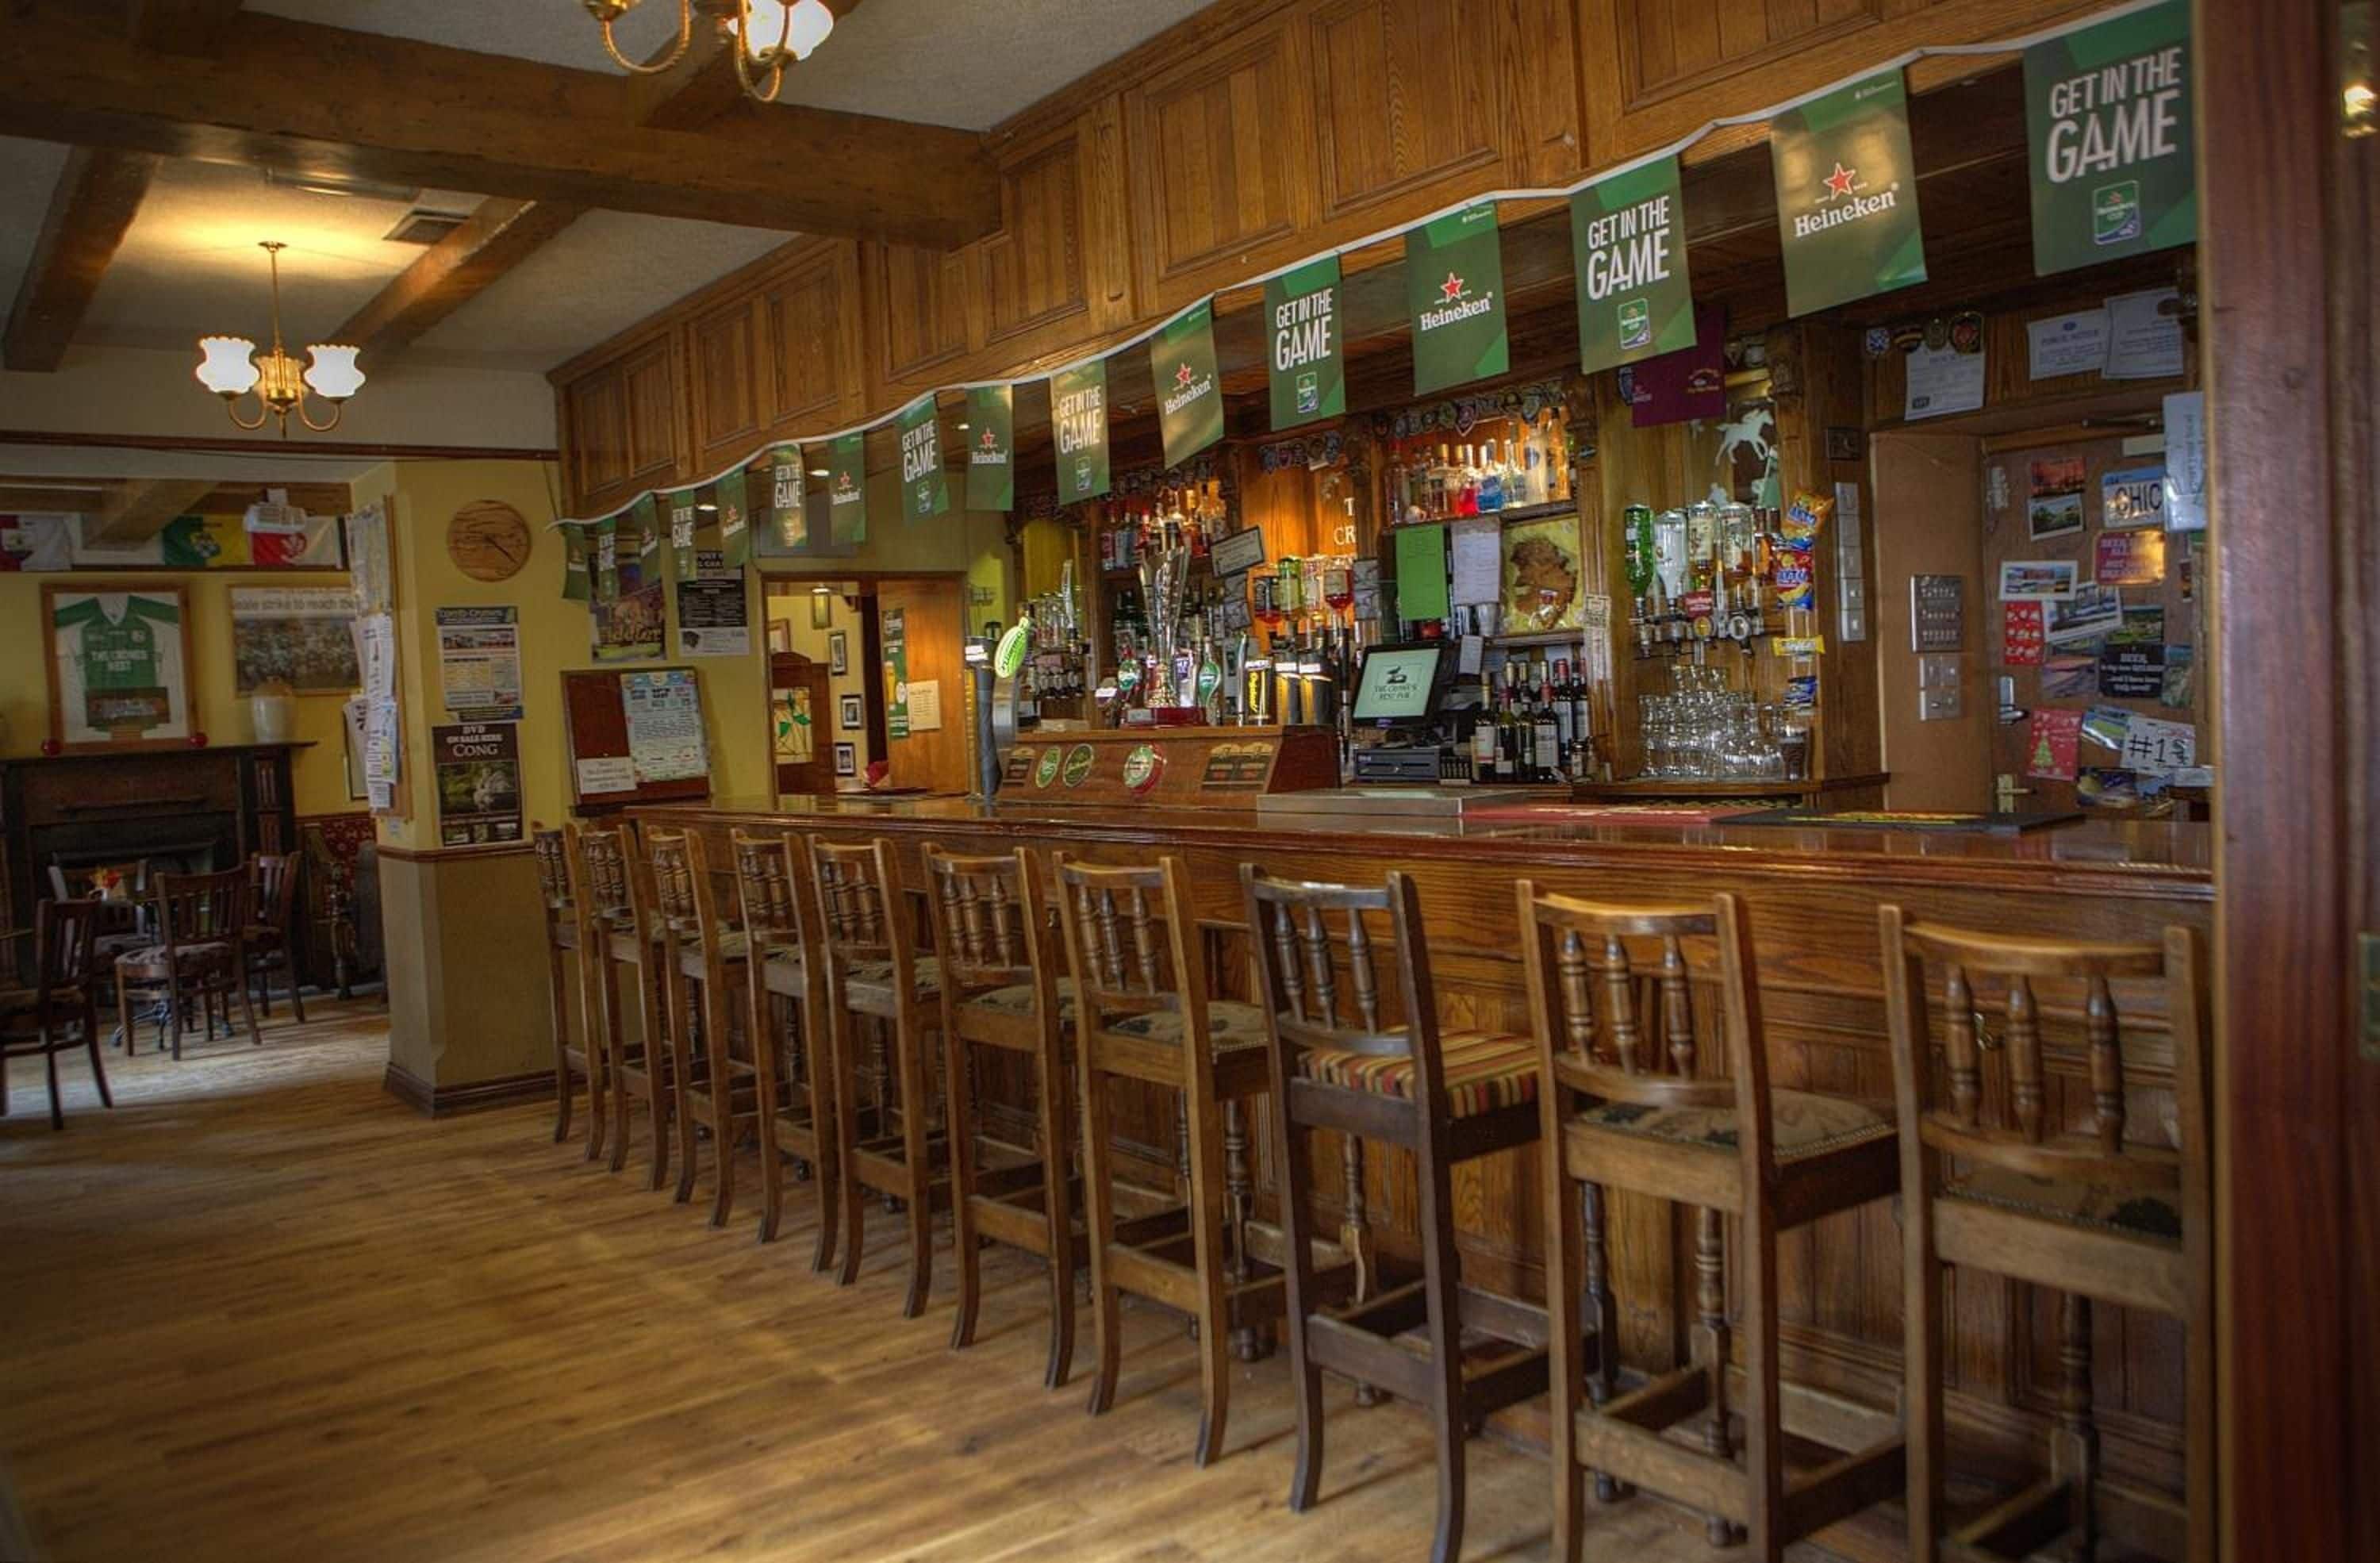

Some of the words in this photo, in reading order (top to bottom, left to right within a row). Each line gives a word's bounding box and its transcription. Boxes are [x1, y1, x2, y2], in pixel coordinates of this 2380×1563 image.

[2051, 72, 2100, 119] GET
[2100, 63, 2128, 105] IN
[2130, 47, 2182, 94] THE
[2046, 88, 2182, 183] GAME
[1588, 213, 1618, 250] GET
[1621, 207, 1637, 239] IN
[1638, 195, 1670, 232] THE
[1794, 191, 1896, 238] Heineken
[1587, 228, 1670, 301] GAME
[1276, 300, 1298, 329] GET
[1299, 296, 1310, 322] IN
[1311, 288, 1333, 317] THE
[1419, 297, 1491, 332] Heineken
[1276, 314, 1333, 371] GAME
[1060, 394, 1076, 417] GET
[1085, 385, 1101, 409] THE
[1164, 379, 1211, 416] Heineken
[1059, 409, 1101, 455] GAME
[903, 439, 937, 483] GAME
[452, 743, 498, 758] CONG
[463, 725, 486, 735] DVD
